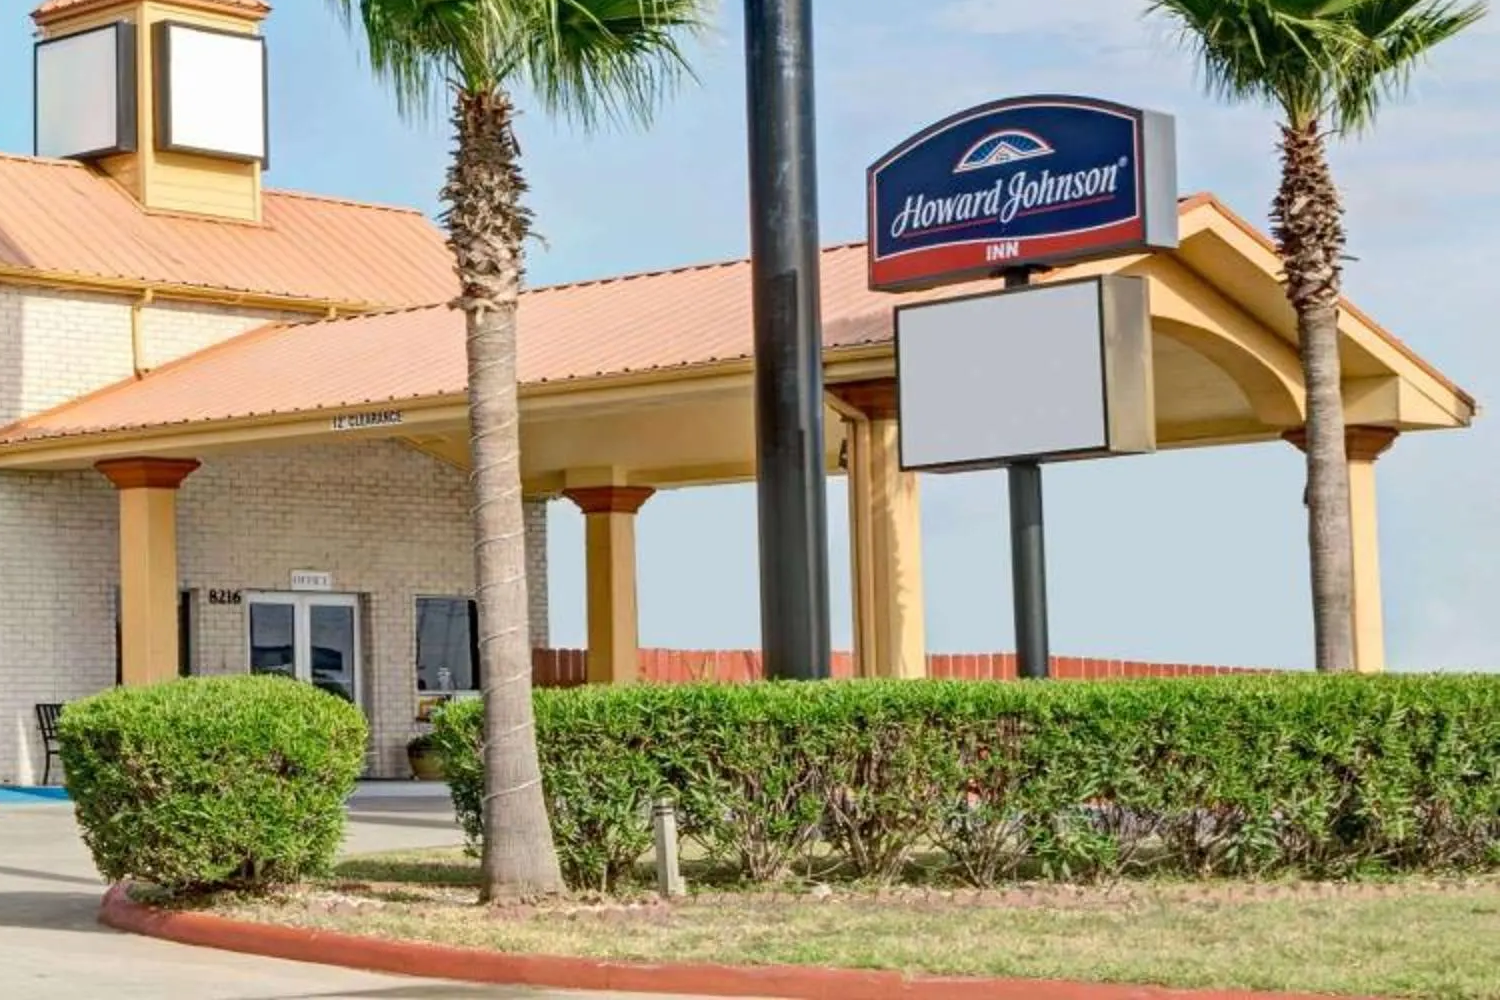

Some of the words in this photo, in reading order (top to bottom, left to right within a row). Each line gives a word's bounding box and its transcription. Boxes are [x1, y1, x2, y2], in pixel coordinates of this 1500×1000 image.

[891, 180, 1000, 238] Howard
[1001, 165, 1117, 223] Johnson
[985, 242, 1019, 261] INN
[209, 589, 241, 604] 8216
